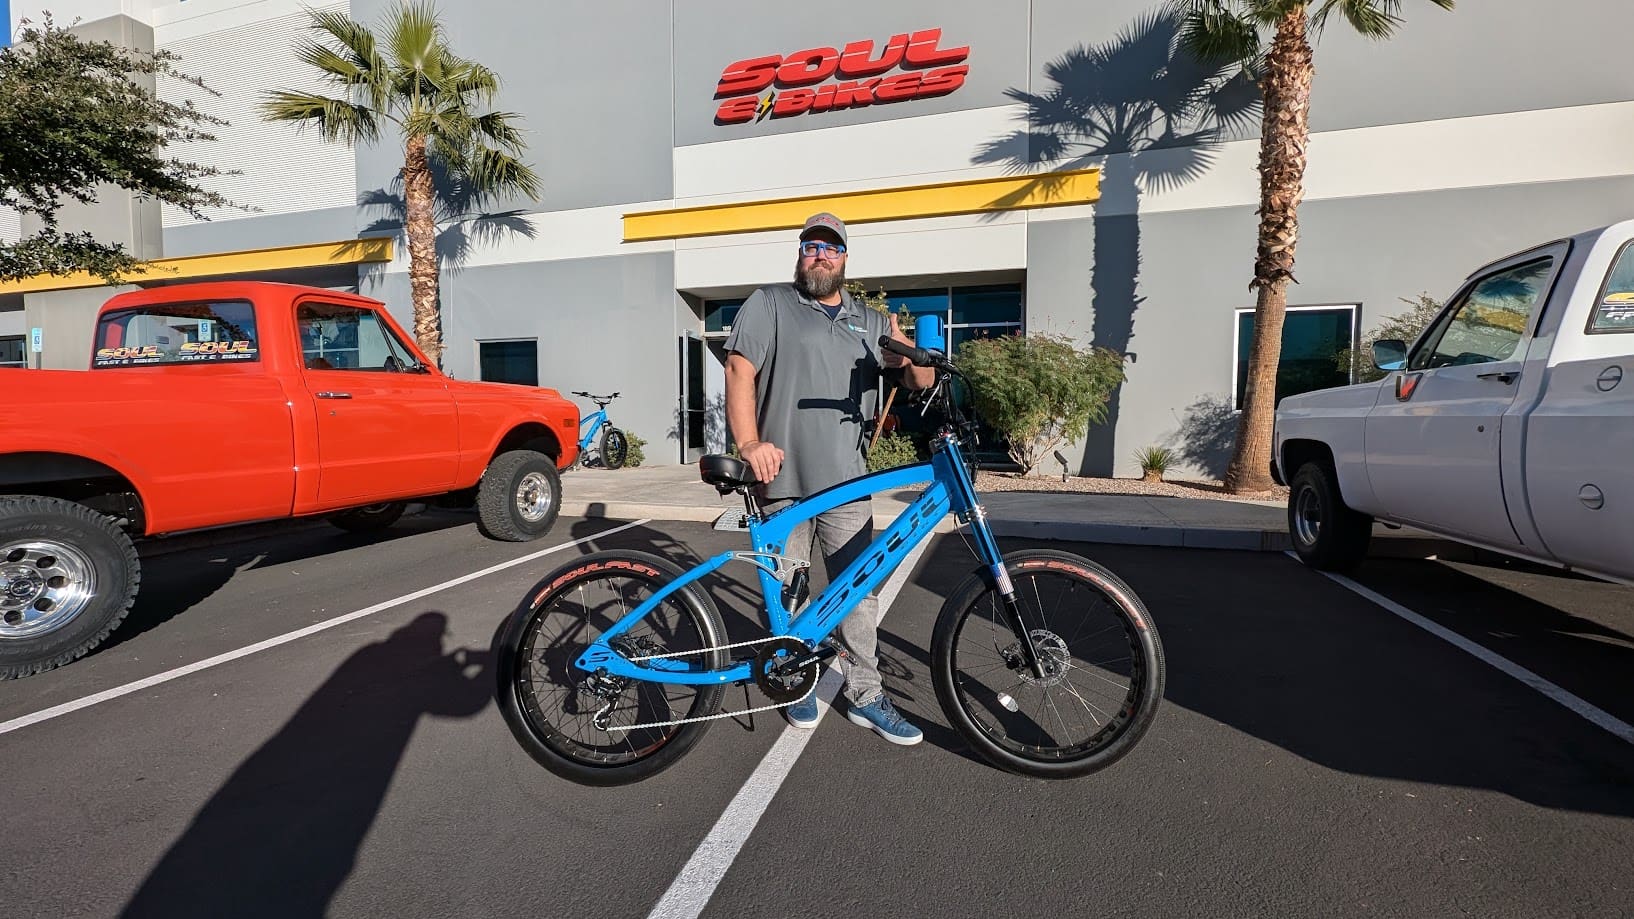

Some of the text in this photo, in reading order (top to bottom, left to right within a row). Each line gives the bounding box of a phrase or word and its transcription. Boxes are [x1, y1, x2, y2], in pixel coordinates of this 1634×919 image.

[714, 27, 970, 100] SOUL
[769, 64, 970, 120] BIKES
[96, 345, 164, 361] SOUL
[178, 340, 257, 355] SOUL
[552, 561, 661, 589] SOUL FAST
